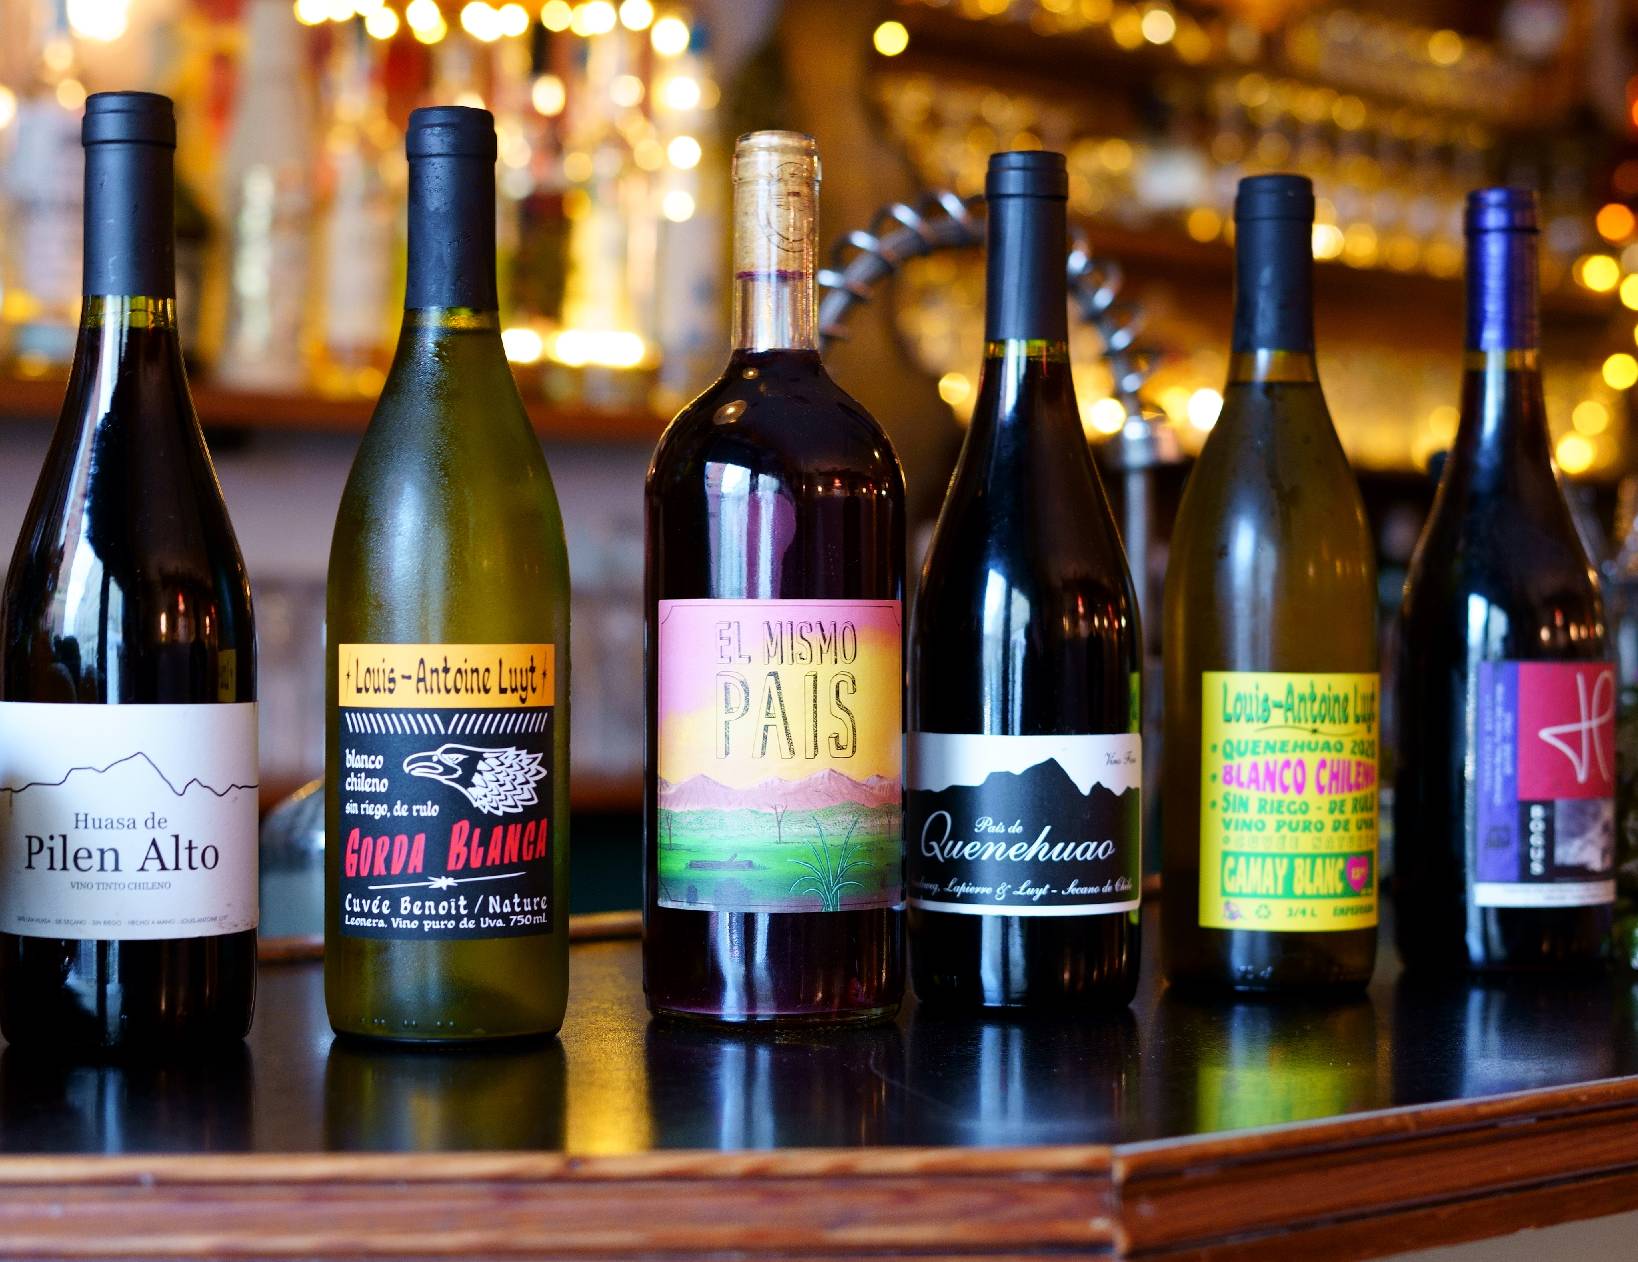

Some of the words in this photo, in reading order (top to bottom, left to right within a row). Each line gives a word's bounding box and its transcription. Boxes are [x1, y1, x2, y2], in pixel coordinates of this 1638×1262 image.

[716, 621, 751, 664] EL
[763, 621, 857, 665] MISMO
[499, 655, 537, 704] Luyt
[716, 671, 857, 759] PAIS
[345, 748, 383, 769] blanco
[1221, 738, 1345, 760] QUENEHUAO
[345, 772, 388, 792] chileno
[1222, 758, 1306, 795] BLANCO
[345, 799, 358, 814] sin
[361, 800, 390, 819] riego,
[393, 800, 409, 816] de
[412, 800, 439, 816] rulo
[1221, 791, 1249, 813] SIN
[1328, 799, 1346, 815] DE
[74, 812, 137, 830] Huasa
[144, 812, 168, 830] de
[1007, 819, 1023, 833] de
[1221, 817, 1267, 832] VINO
[1275, 819, 1325, 832] PURO
[1331, 819, 1350, 832] DE
[345, 827, 426, 878] GORDA
[446, 818, 548, 871] BLANCA
[921, 810, 1116, 863] Quenehuao
[25, 834, 123, 872] Pilen
[136, 834, 219, 872] Alto
[70, 881, 94, 890] VINO
[95, 881, 126, 890] TINTO
[127, 881, 172, 890] CHILENO
[1223, 855, 1289, 895] GAMAY
[1292, 856, 1345, 896] BLANC
[943, 877, 993, 898] Lapierre
[994, 881, 1012, 900] &
[1012, 879, 1050, 901] Luyt
[1061, 878, 1100, 895] Secano
[1102, 879, 1113, 893] de
[345, 893, 391, 914] Cuvée
[488, 893, 548, 914] Nature
[391, 917, 419, 928] Vino
[423, 918, 456, 932] puro
[459, 917, 476, 929] de
[510, 914, 532, 926] 750
